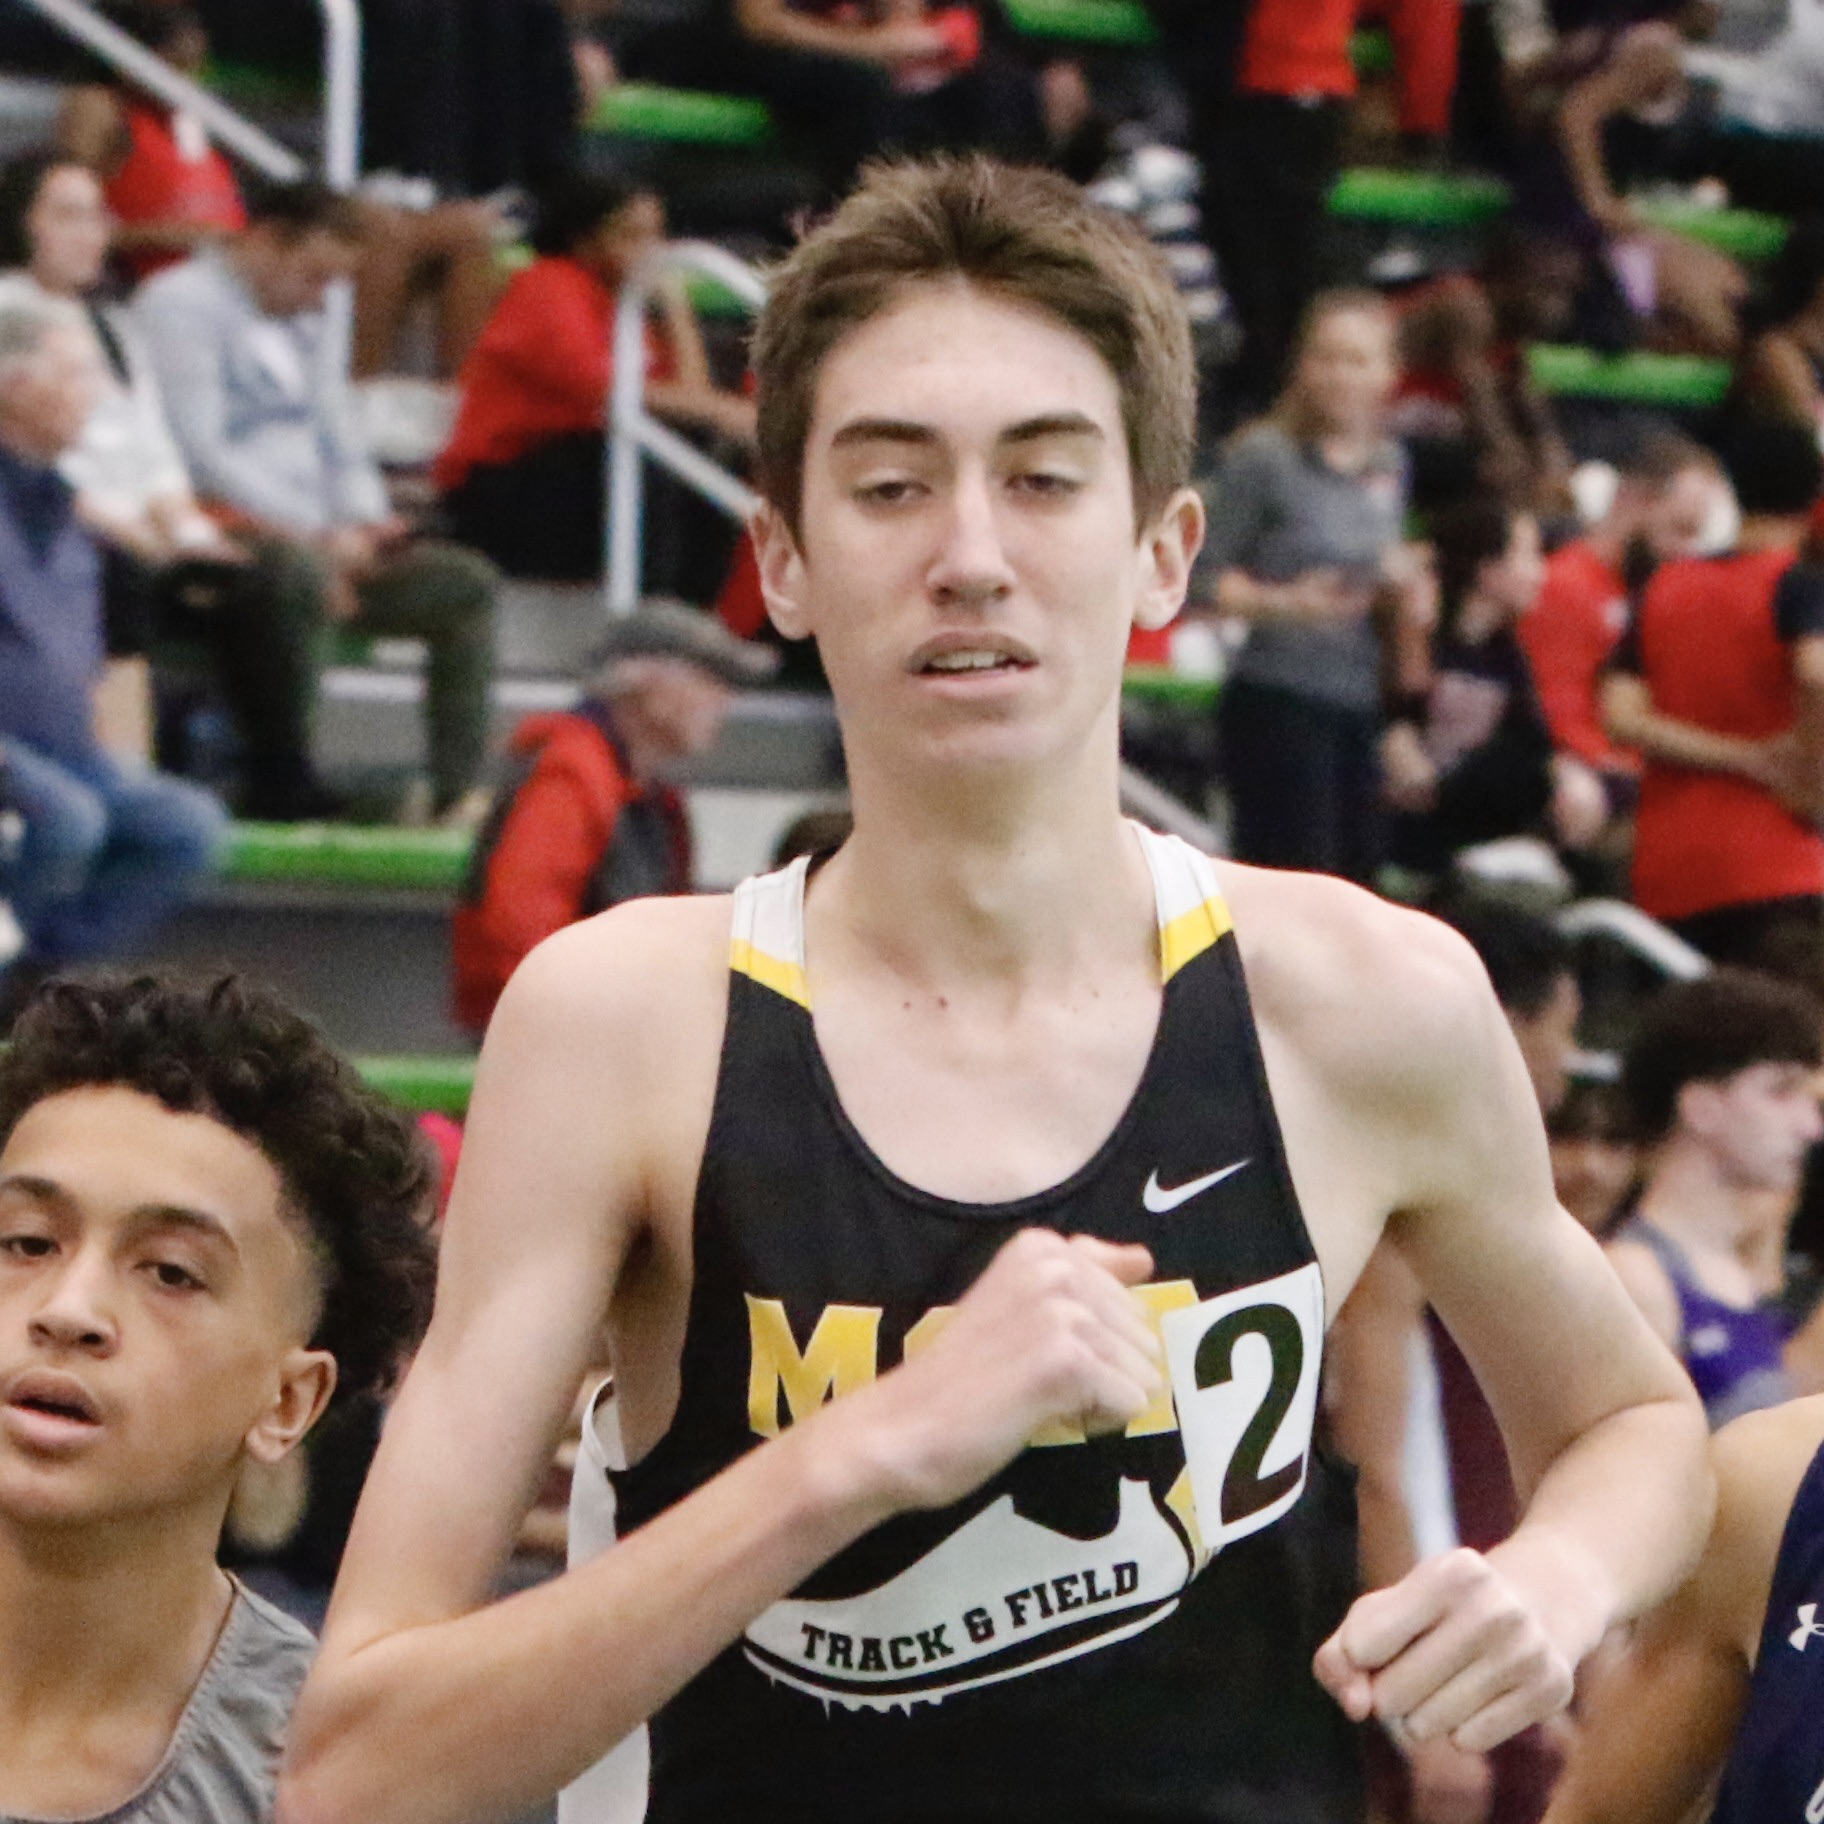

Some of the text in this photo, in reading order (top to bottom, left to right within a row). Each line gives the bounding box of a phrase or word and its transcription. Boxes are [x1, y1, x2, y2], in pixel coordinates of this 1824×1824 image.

[1194, 1302, 1306, 1527] 2
[799, 1560, 1140, 1674] TRACK & FIELD
